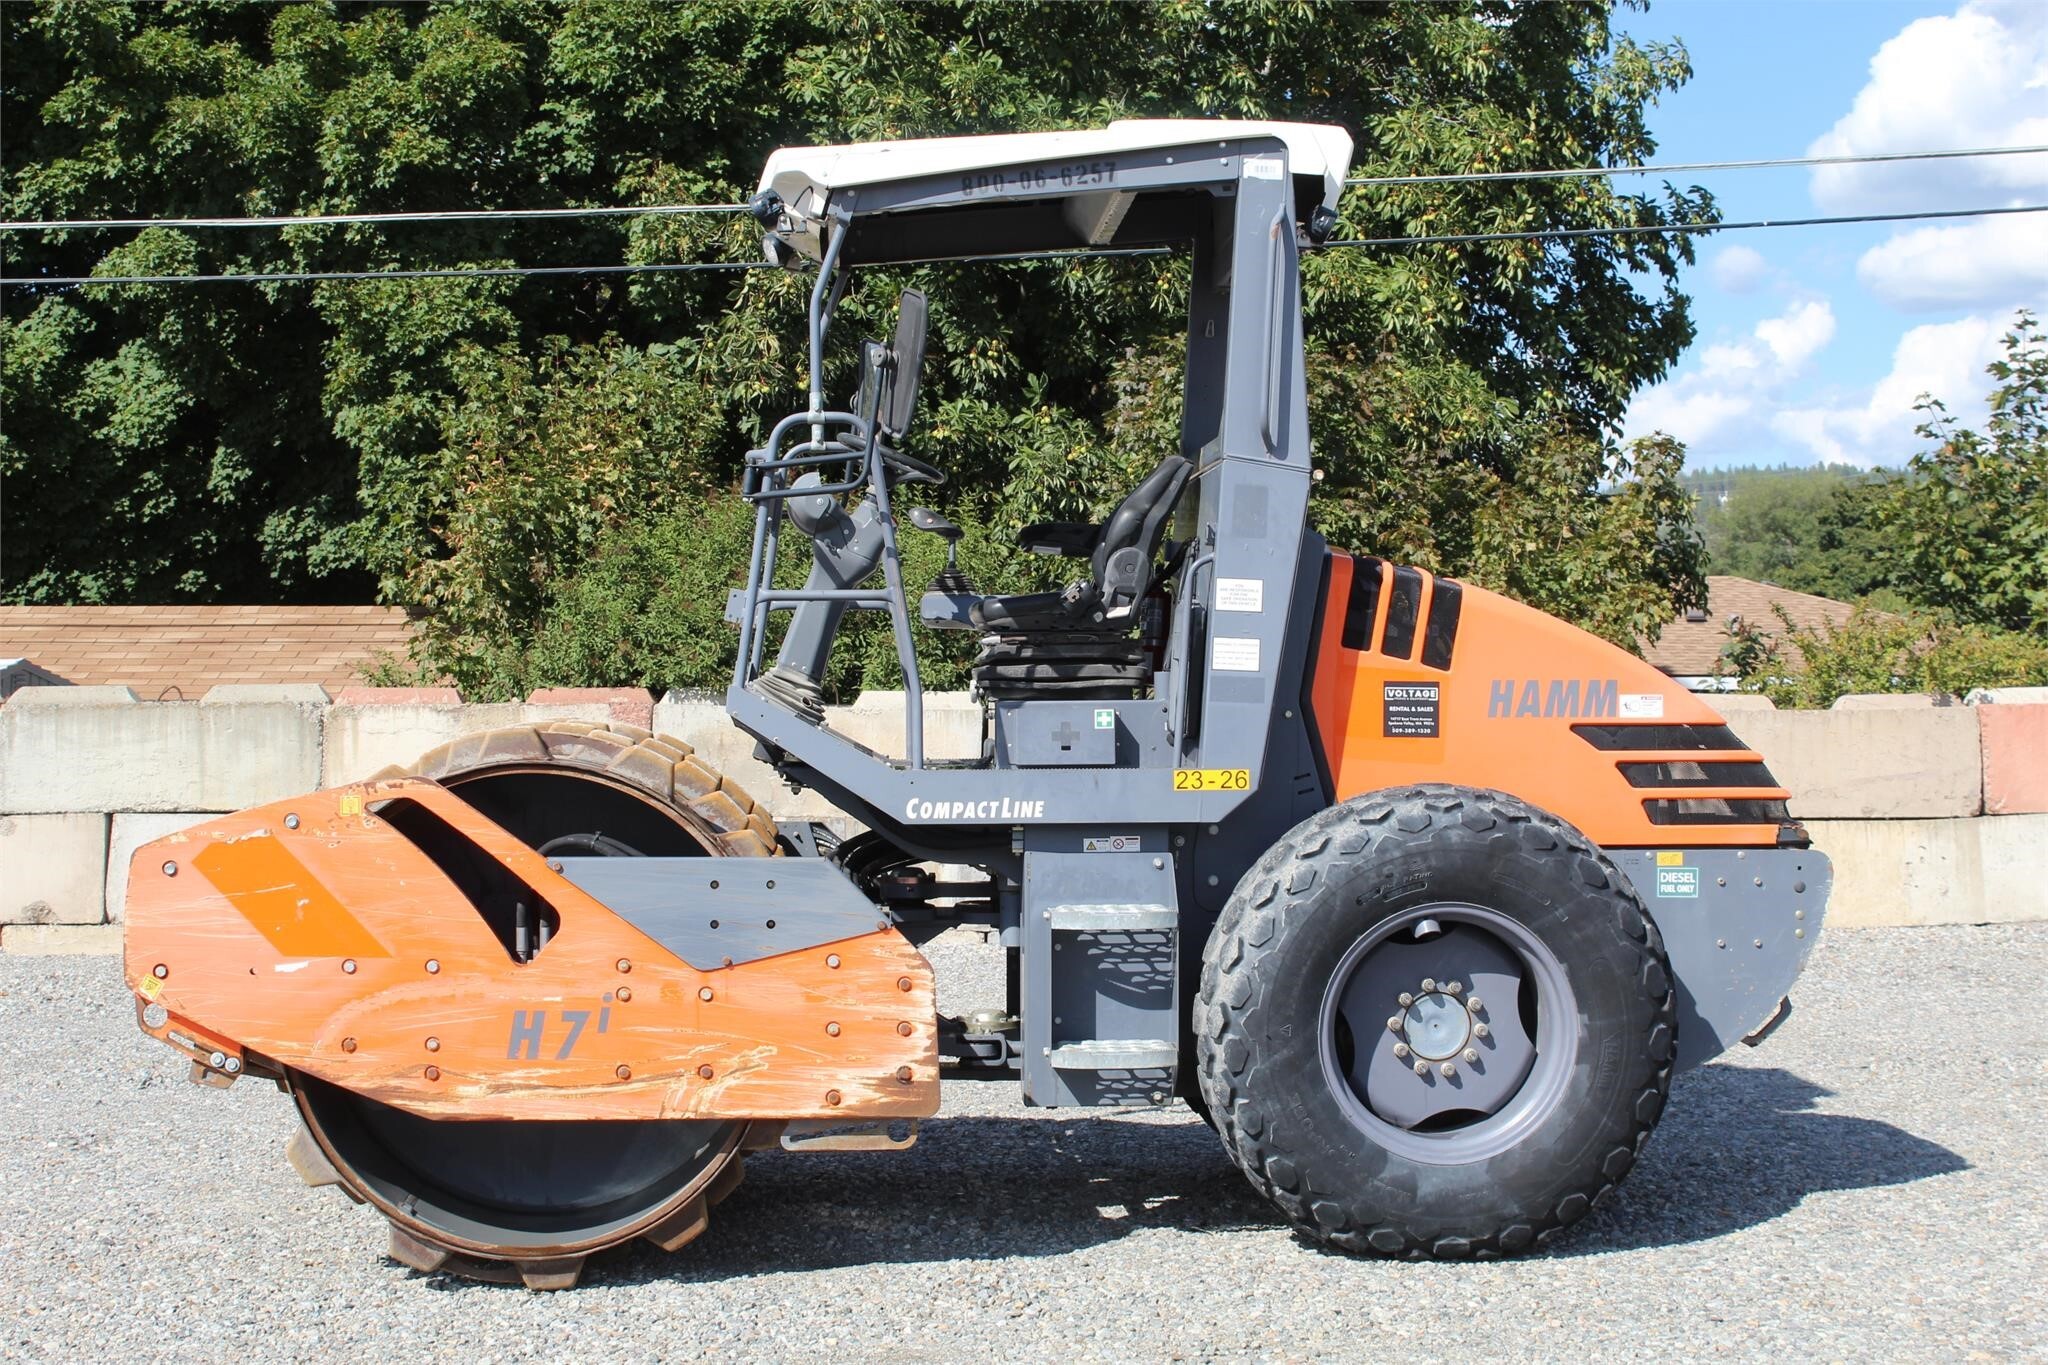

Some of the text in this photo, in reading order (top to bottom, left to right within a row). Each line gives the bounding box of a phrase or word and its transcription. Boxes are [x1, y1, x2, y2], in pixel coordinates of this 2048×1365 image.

[1388, 690, 1436, 698] VOLTAGE
[1487, 679, 1618, 718] HAMM
[1176, 770, 1248, 790] 23-26
[1660, 872, 1696, 883] DIESEL
[1660, 884, 1695, 893] FUEL ONLY
